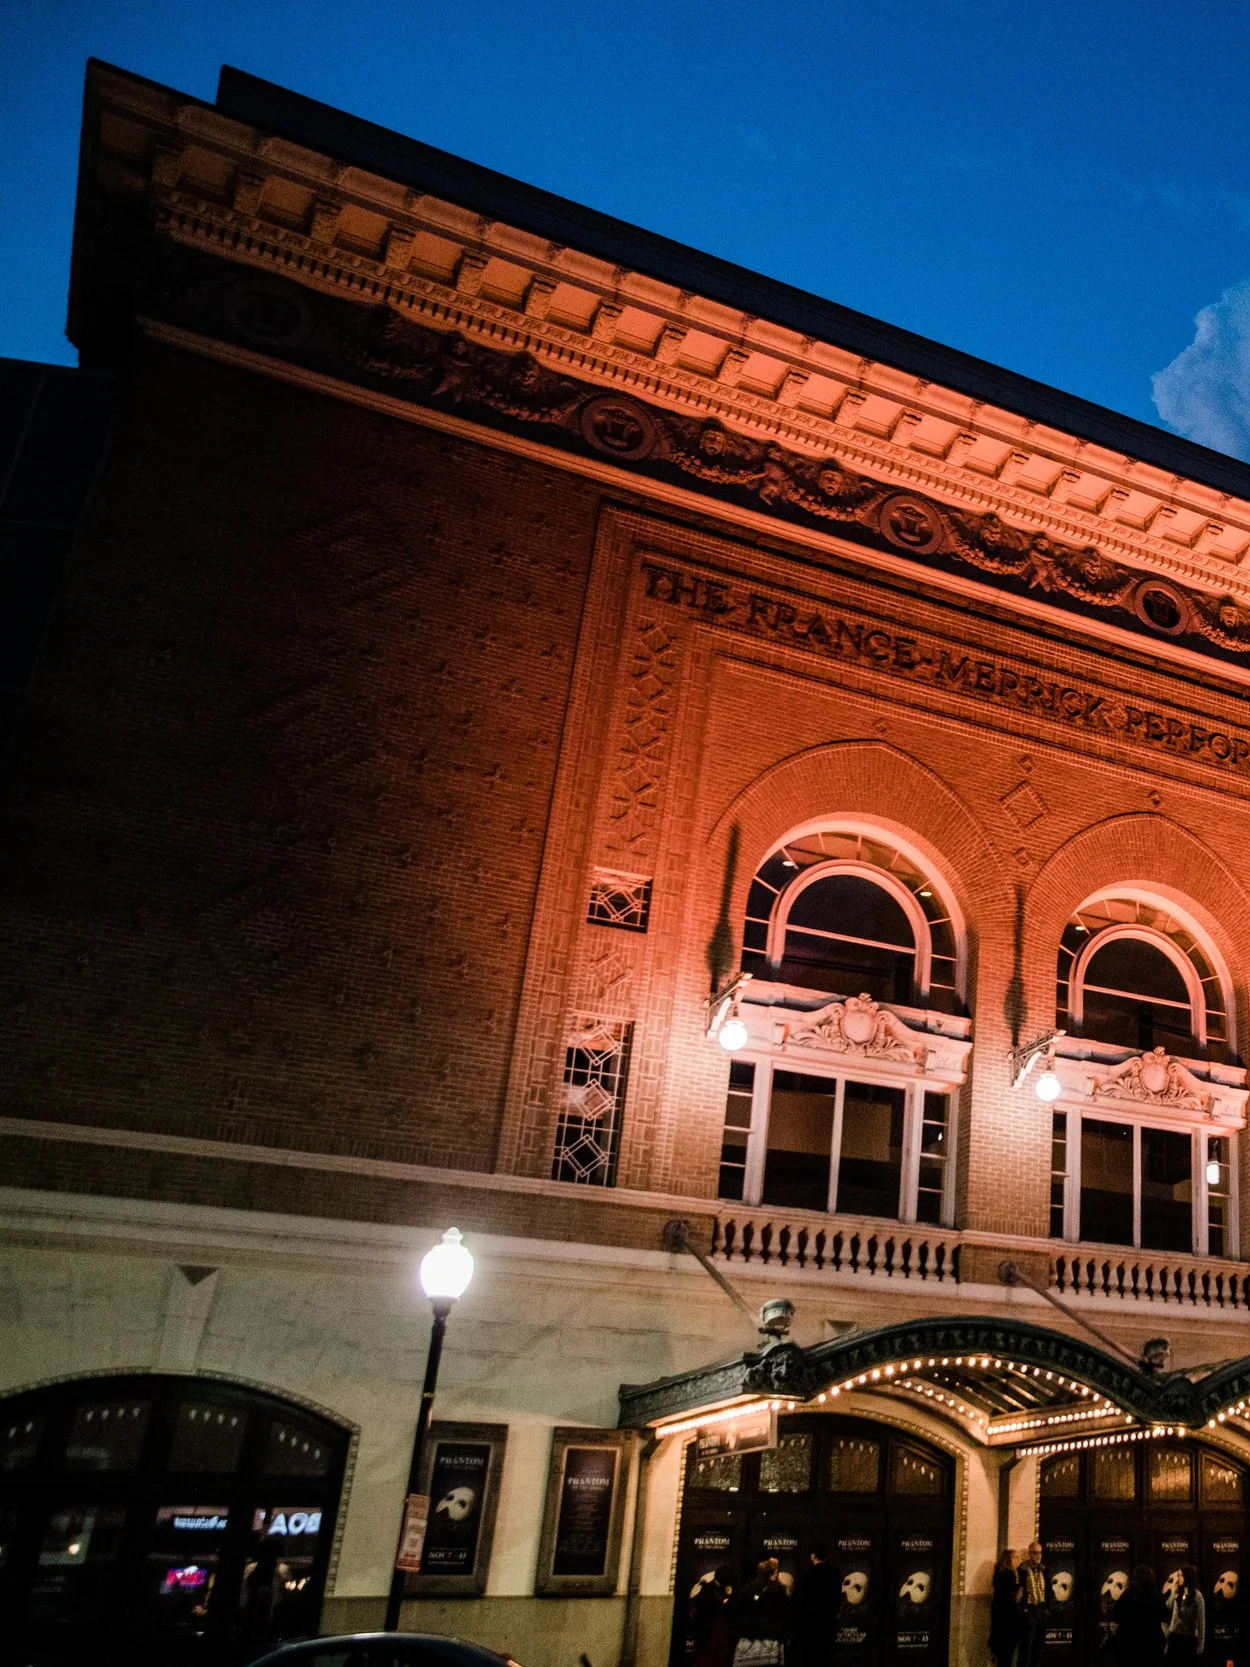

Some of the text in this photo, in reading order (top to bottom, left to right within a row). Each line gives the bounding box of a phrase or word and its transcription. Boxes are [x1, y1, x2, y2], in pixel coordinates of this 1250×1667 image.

[643, 568, 731, 616] THE
[440, 1456, 484, 1466] PHANTOM
[568, 1478, 610, 1486] PHANTOM
[694, 1538, 730, 1546] PHANTOM
